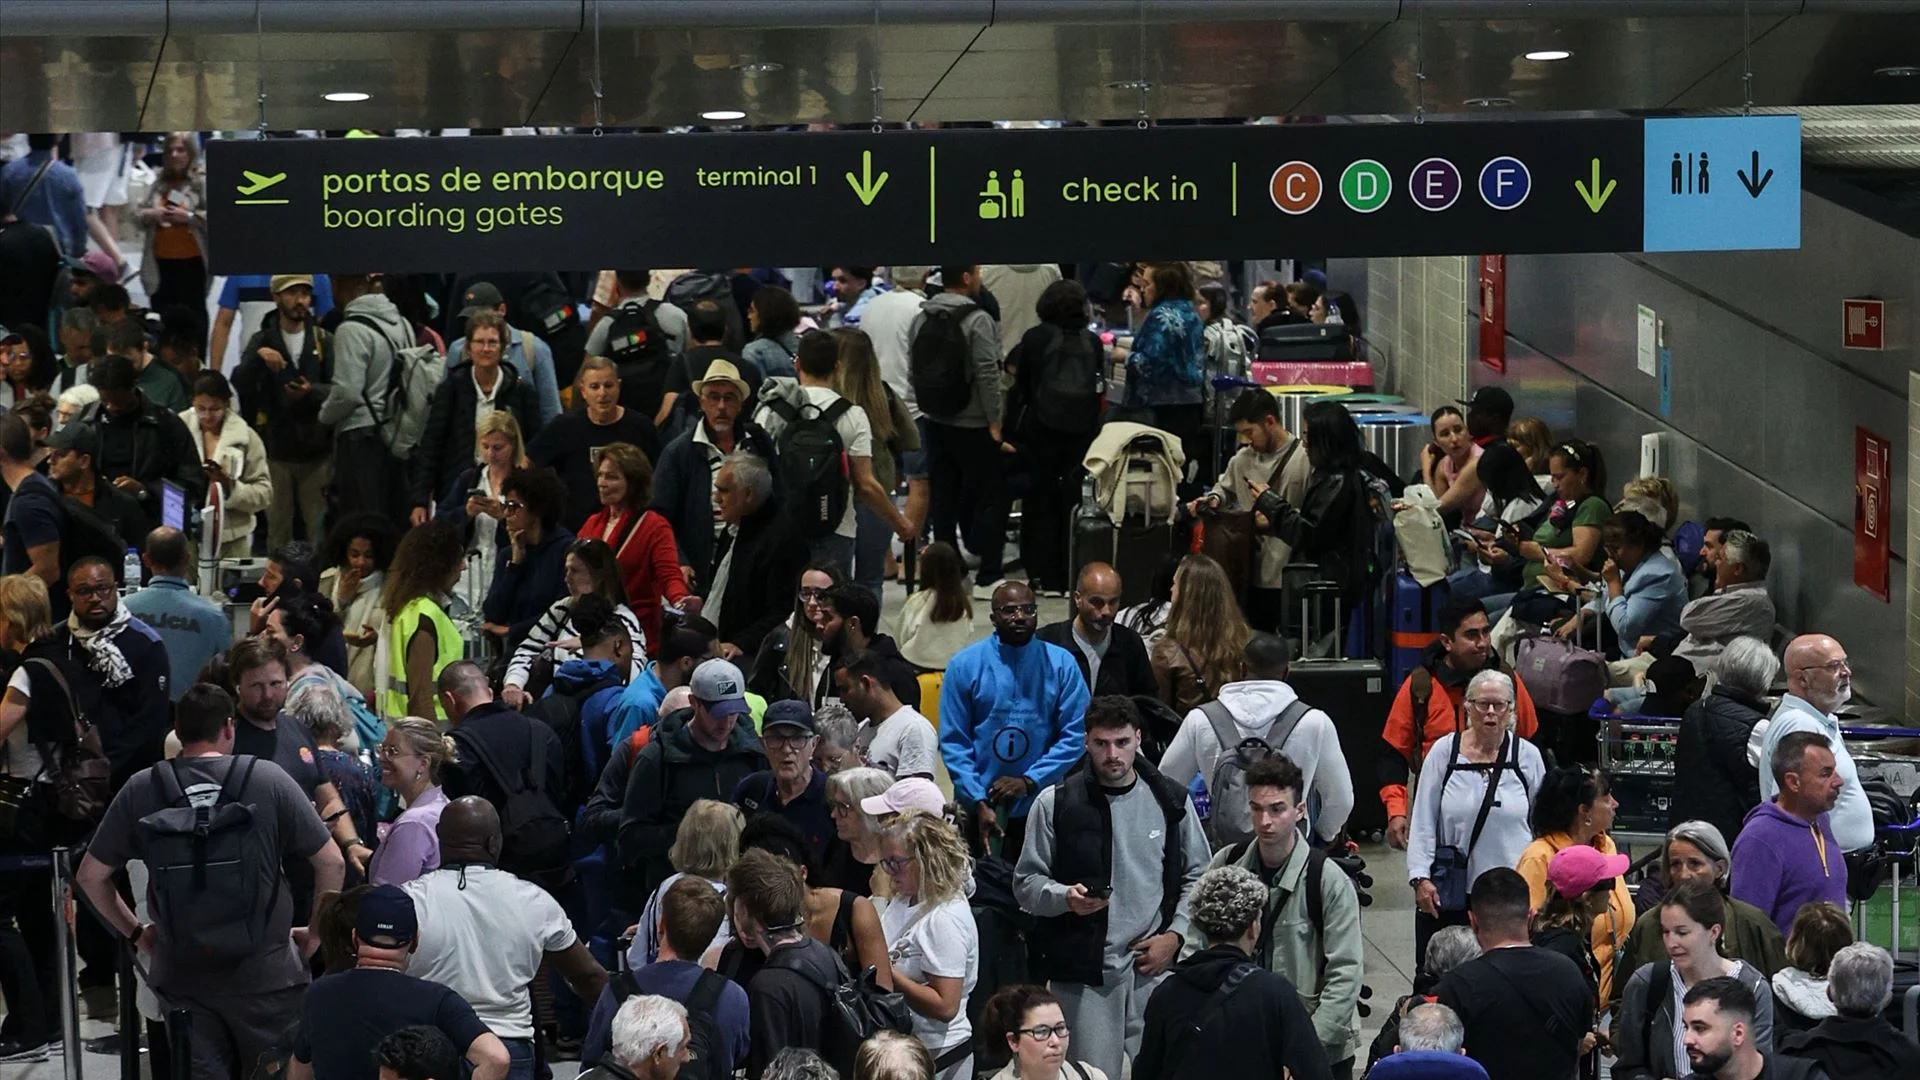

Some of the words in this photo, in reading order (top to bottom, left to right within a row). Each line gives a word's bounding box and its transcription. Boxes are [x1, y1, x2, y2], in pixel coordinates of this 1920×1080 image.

[322, 169, 431, 200] portas
[440, 166, 482, 192] de
[491, 165, 665, 196] embarque
[696, 165, 801, 187] terminal
[809, 165, 817, 186] 1
[1062, 175, 1159, 202] check
[1171, 174, 1198, 201] in
[1286, 172, 1307, 202] C
[1357, 171, 1378, 201] D
[1426, 170, 1445, 199] E
[1497, 169, 1516, 198] F
[323, 203, 465, 233] boarding
[475, 202, 564, 233] gates
